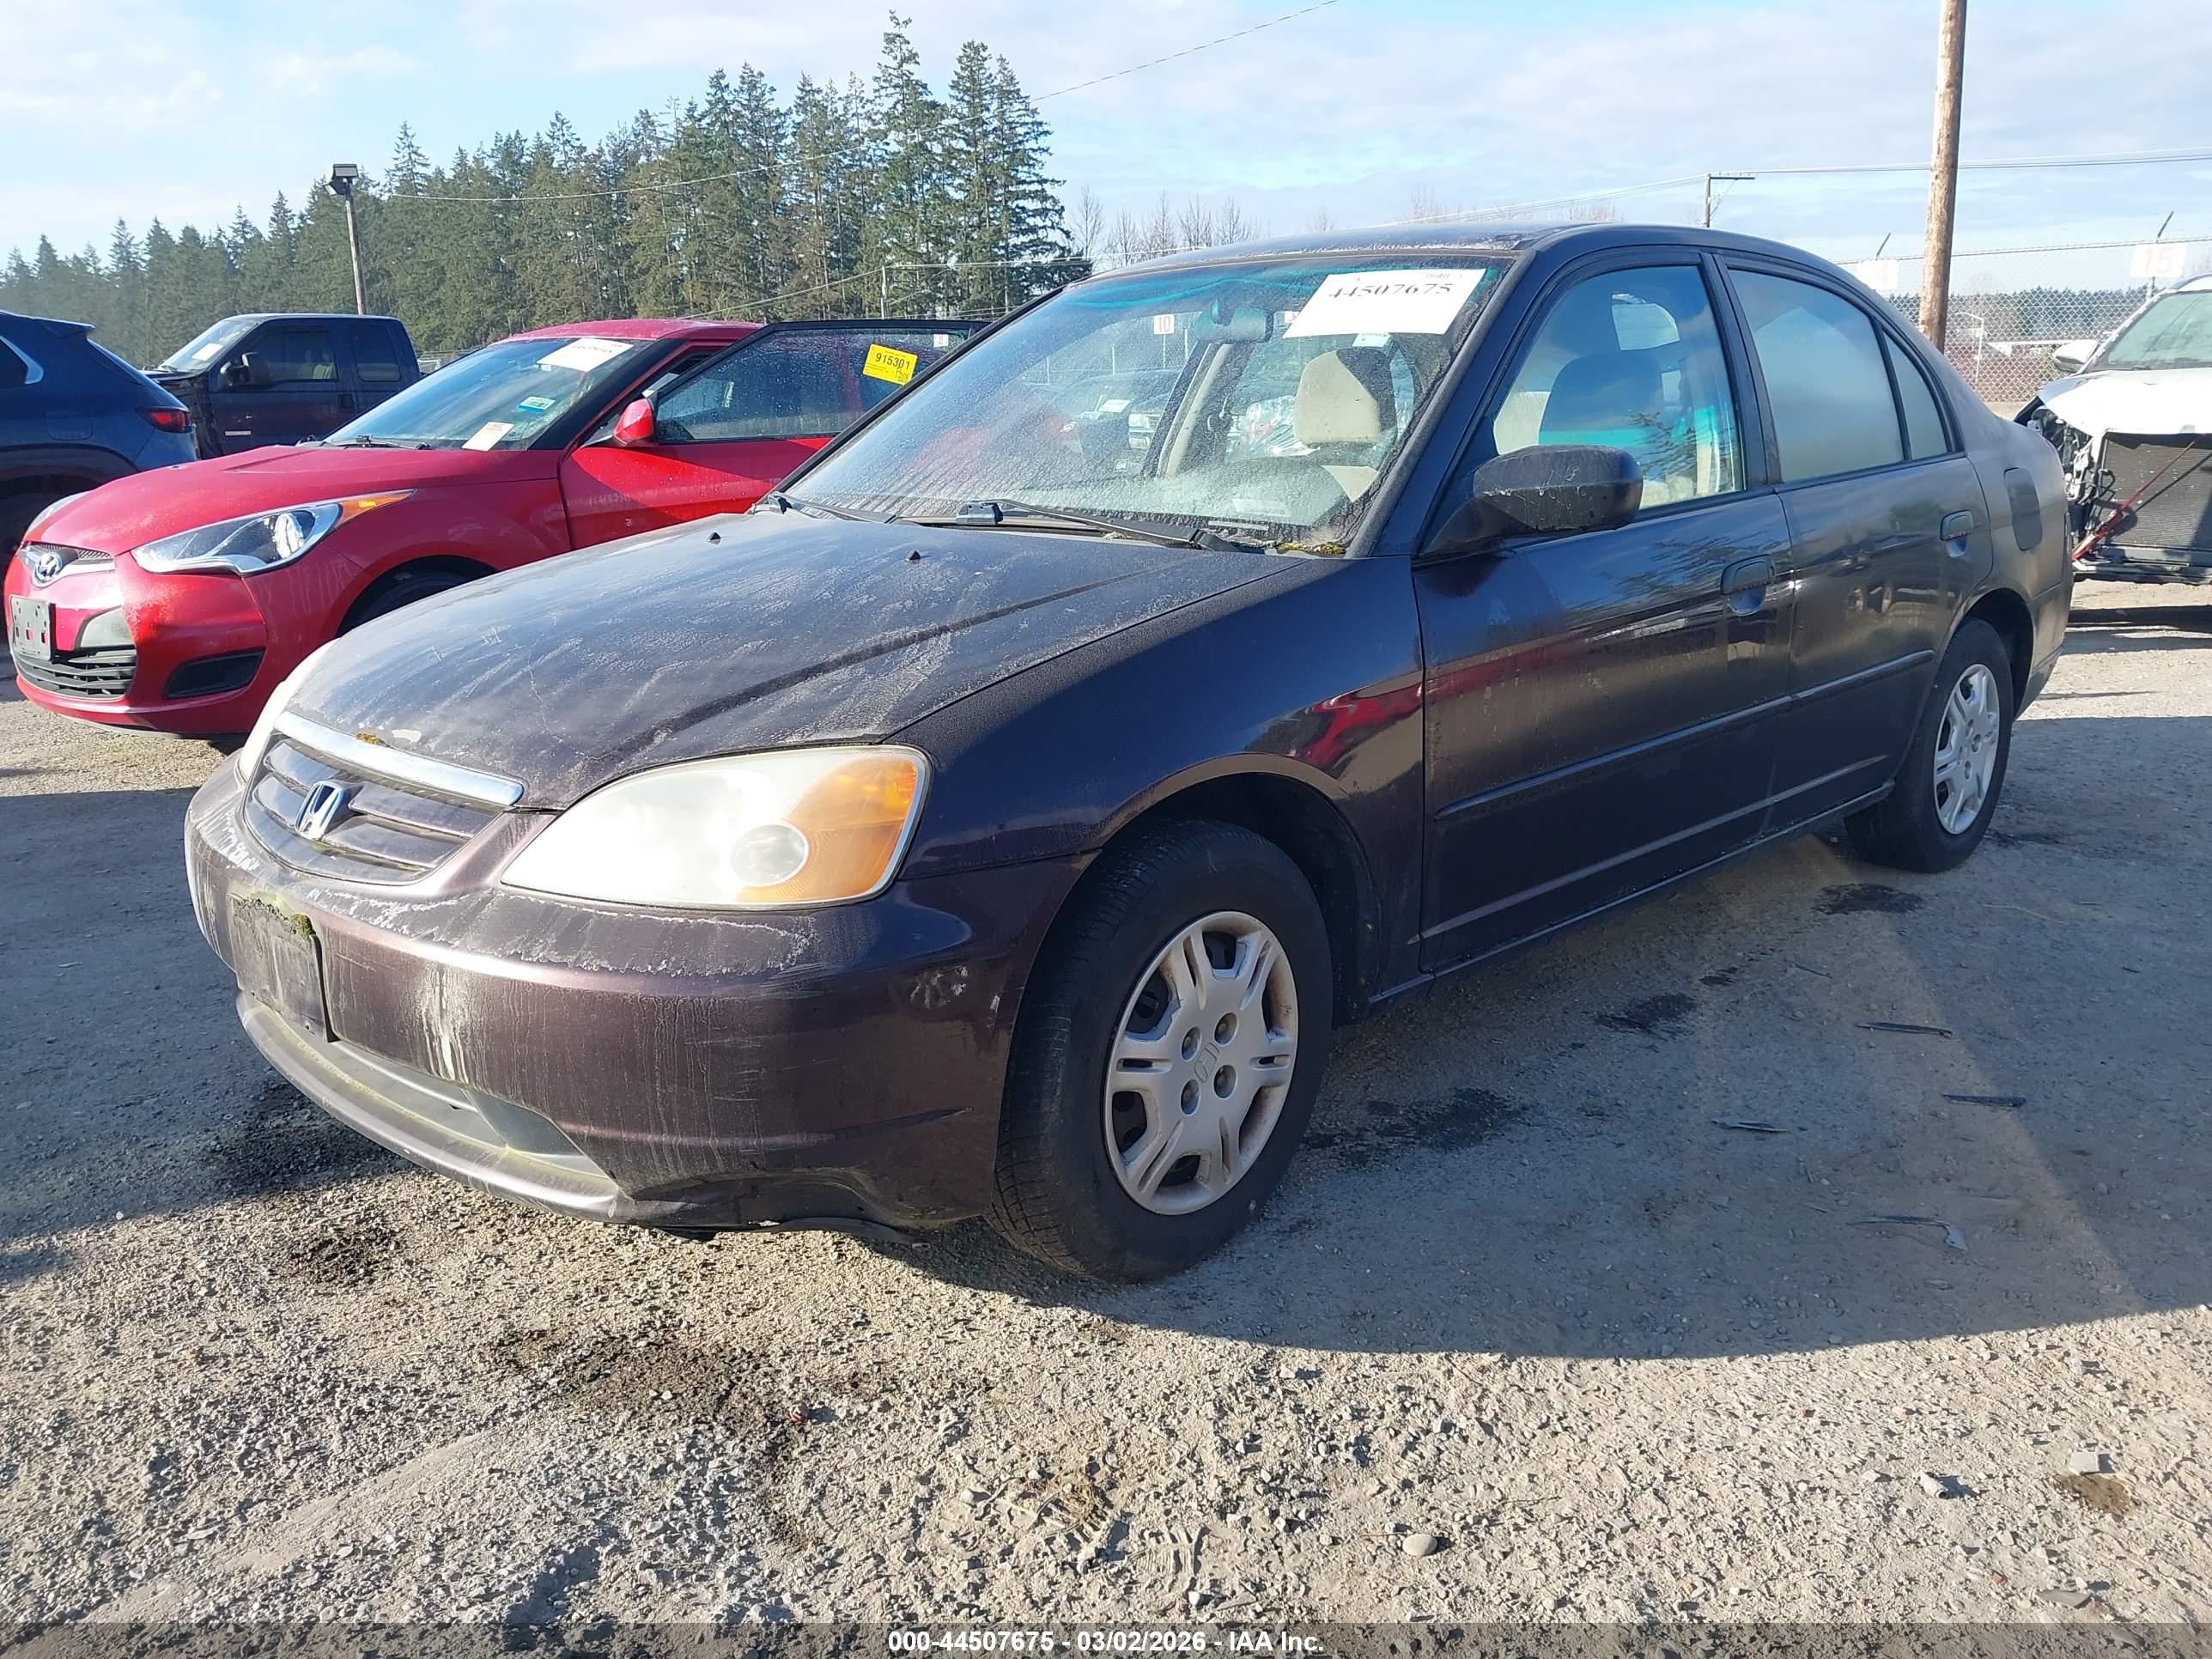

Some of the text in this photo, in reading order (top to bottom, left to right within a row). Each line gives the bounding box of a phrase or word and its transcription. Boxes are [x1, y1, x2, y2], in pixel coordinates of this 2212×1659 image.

[2144, 246, 2173, 274] 15
[1328, 283, 1454, 299] 44507675
[1158, 315, 1171, 332] 10
[874, 352, 910, 370] 915301
